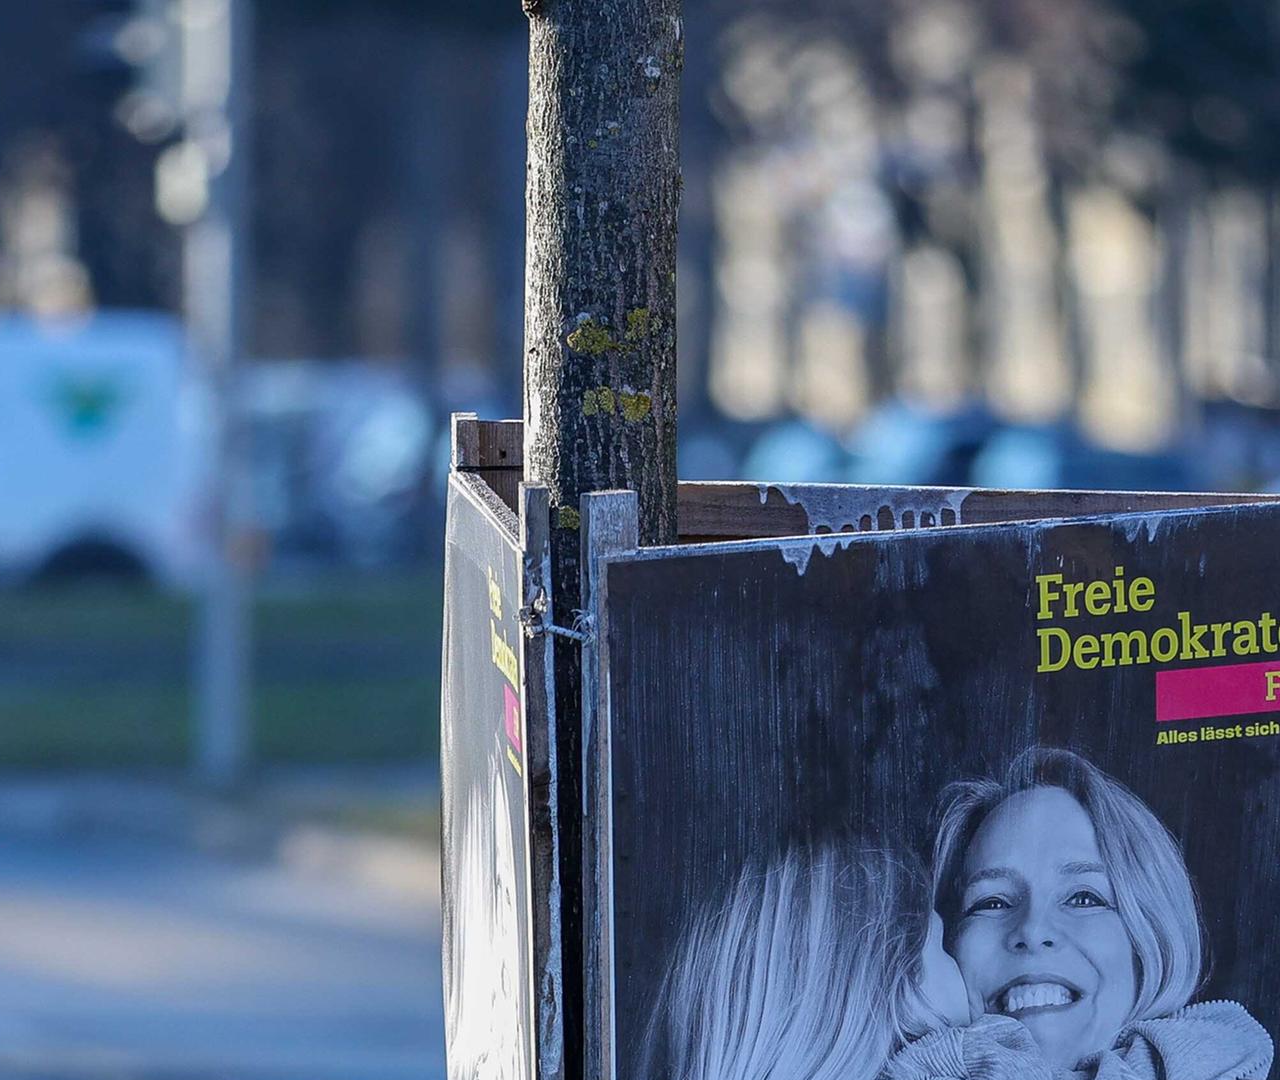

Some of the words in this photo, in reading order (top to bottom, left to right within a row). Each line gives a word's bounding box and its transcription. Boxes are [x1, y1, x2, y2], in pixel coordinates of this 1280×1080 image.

[1035, 566, 1156, 620] Freie
[1156, 727, 1198, 745] Alles
[1201, 724, 1242, 741] lässt
[1245, 721, 1280, 737] sich
